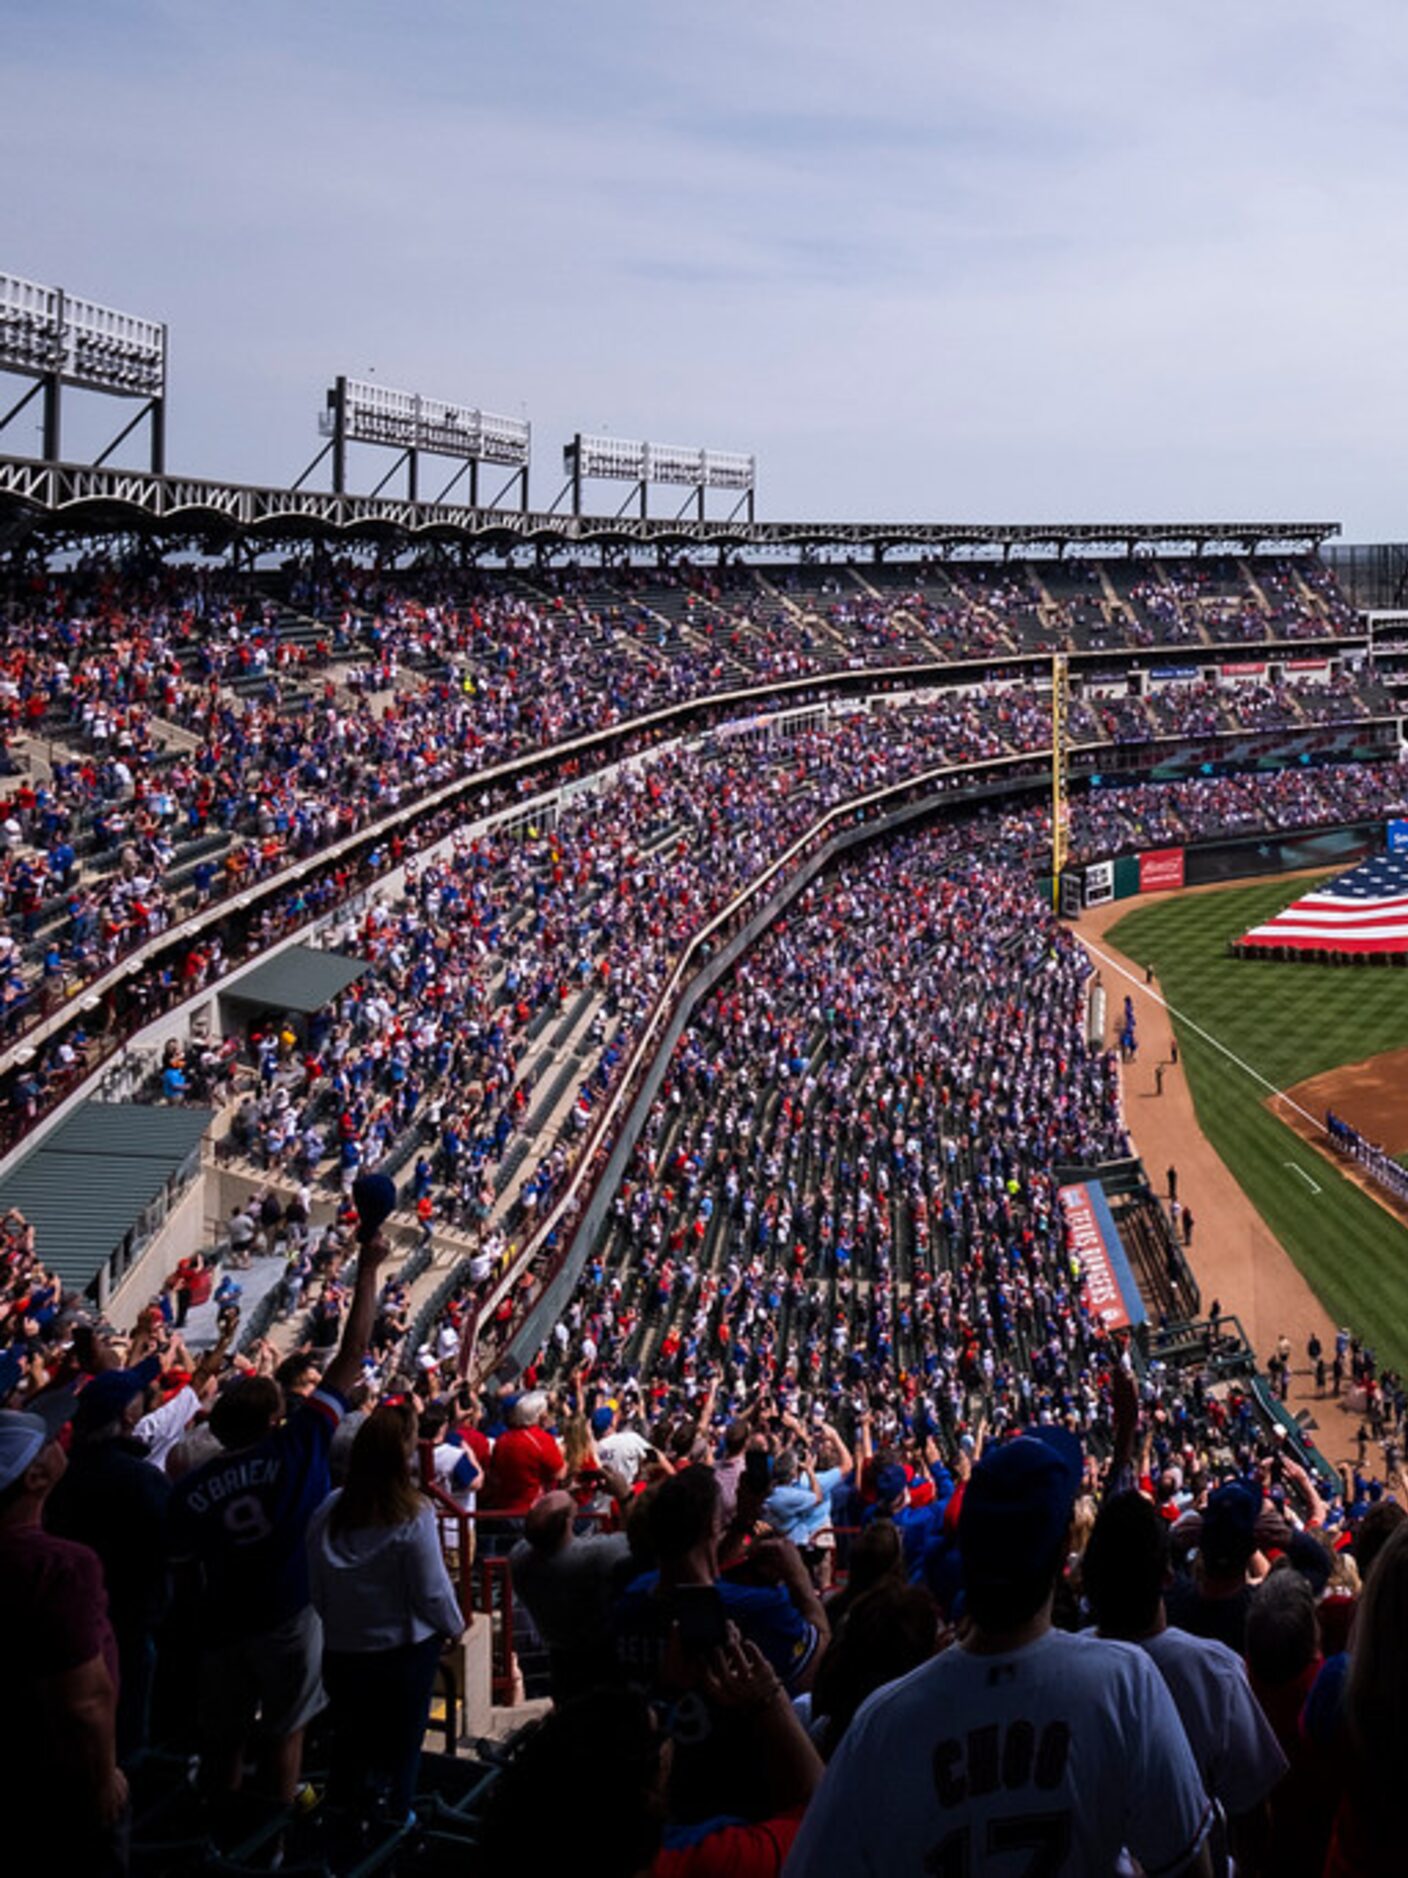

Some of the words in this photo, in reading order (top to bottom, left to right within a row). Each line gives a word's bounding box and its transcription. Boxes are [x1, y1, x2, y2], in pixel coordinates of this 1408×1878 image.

[186, 1457, 280, 1514] O'BRIEN
[223, 1494, 272, 1546] 9
[932, 1719, 1070, 1810] CHOO
